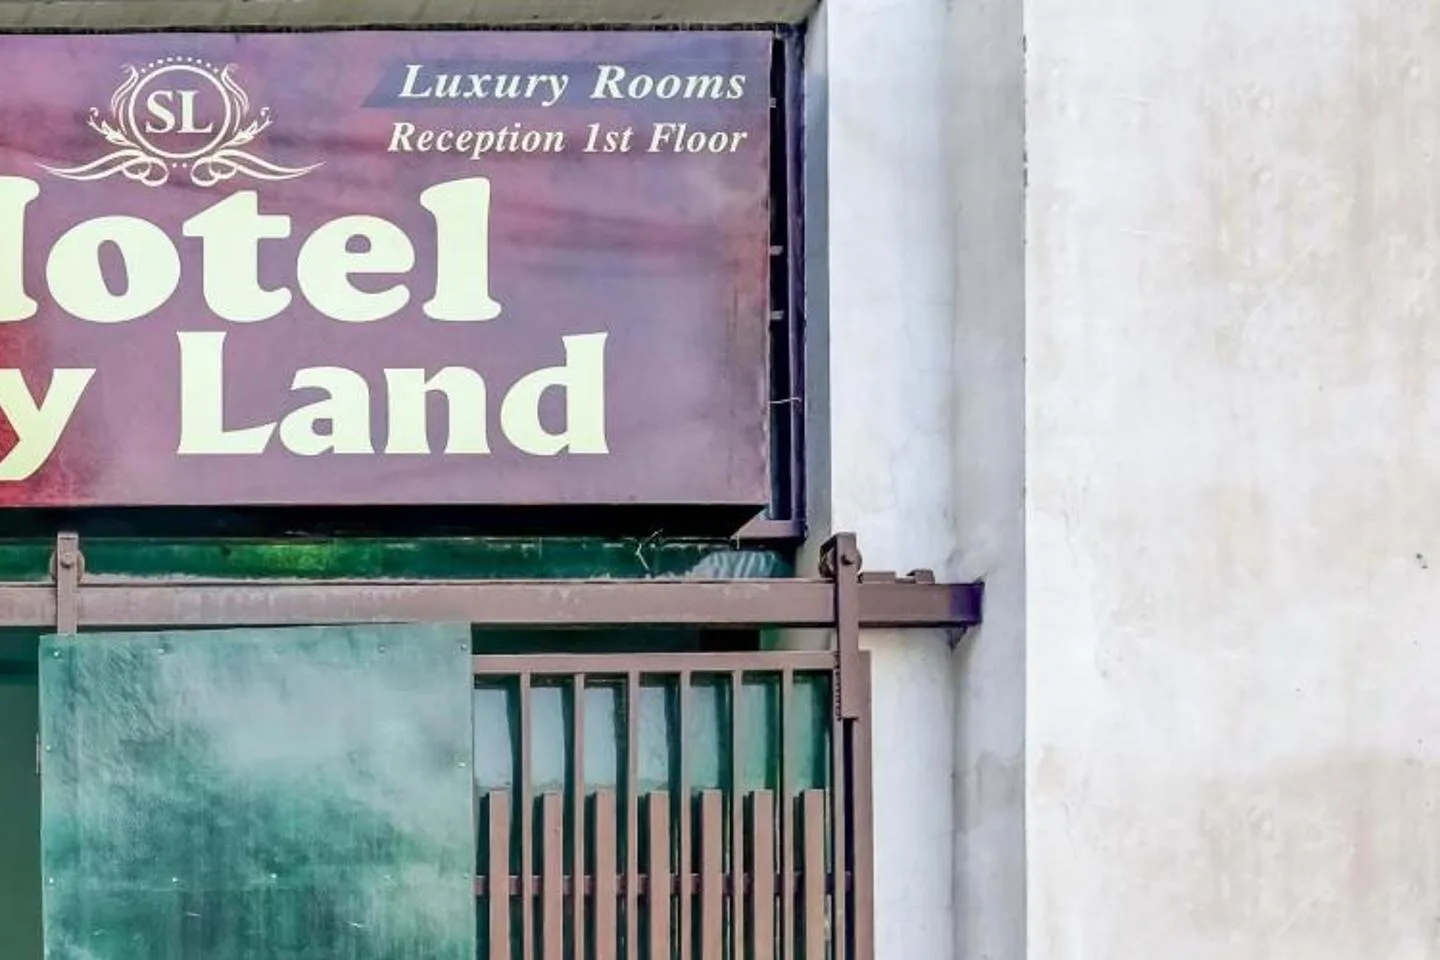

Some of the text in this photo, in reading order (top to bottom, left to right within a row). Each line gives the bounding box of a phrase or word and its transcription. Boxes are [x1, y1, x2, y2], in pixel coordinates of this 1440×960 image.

[397, 64, 746, 107] Luxury Rooms
[144, 89, 213, 135] SL
[387, 121, 749, 160] Reception 1st Floor
[175, 329, 610, 457] Land
